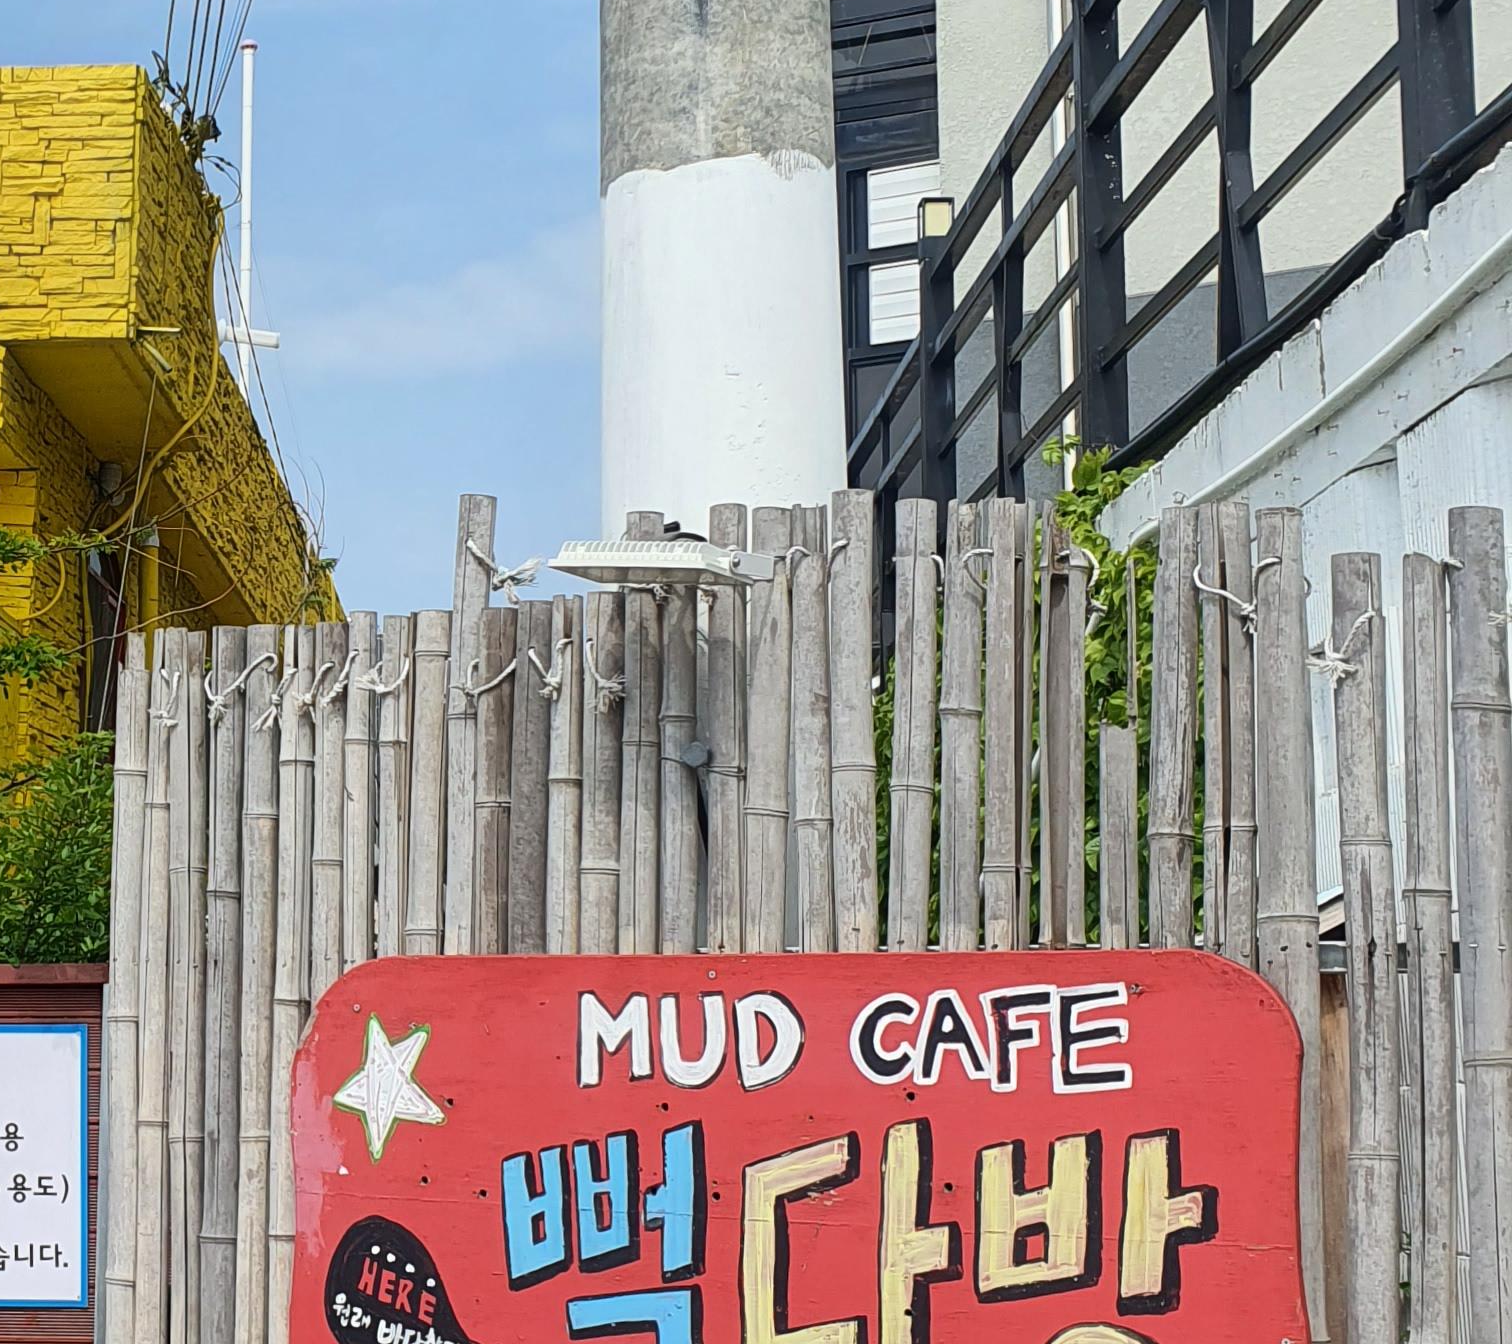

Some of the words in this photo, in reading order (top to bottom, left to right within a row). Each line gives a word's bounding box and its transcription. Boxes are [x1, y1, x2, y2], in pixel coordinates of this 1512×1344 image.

[578, 989, 806, 1093] MUD
[849, 981, 1135, 1095] CAFE
[7, 1173, 70, 1205] 용도)
[357, 1256, 437, 1326] HERE
